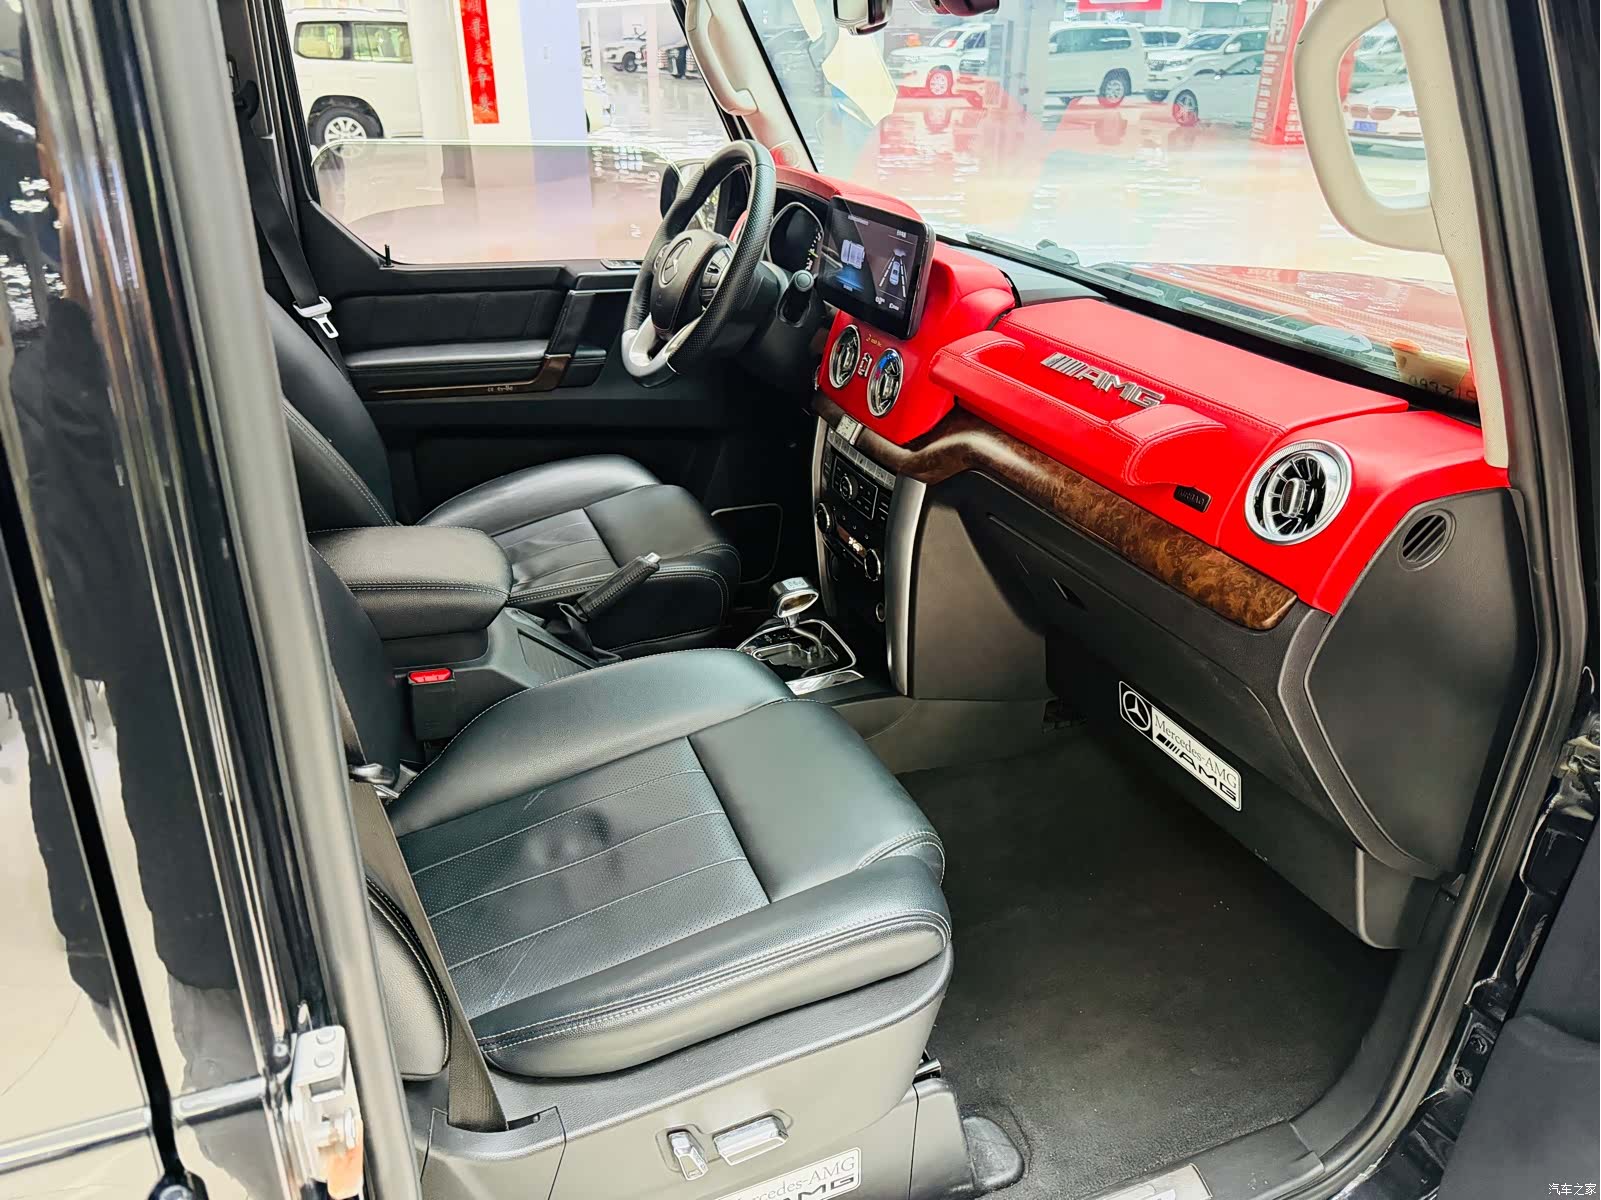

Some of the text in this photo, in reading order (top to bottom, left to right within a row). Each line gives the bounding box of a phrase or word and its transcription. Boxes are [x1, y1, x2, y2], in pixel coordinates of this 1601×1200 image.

[1076, 365, 1166, 409] AMG
[1155, 714, 1237, 789] Mercedes-AMG
[1178, 751, 1237, 802] AMG
[783, 1174, 854, 1200] MG
